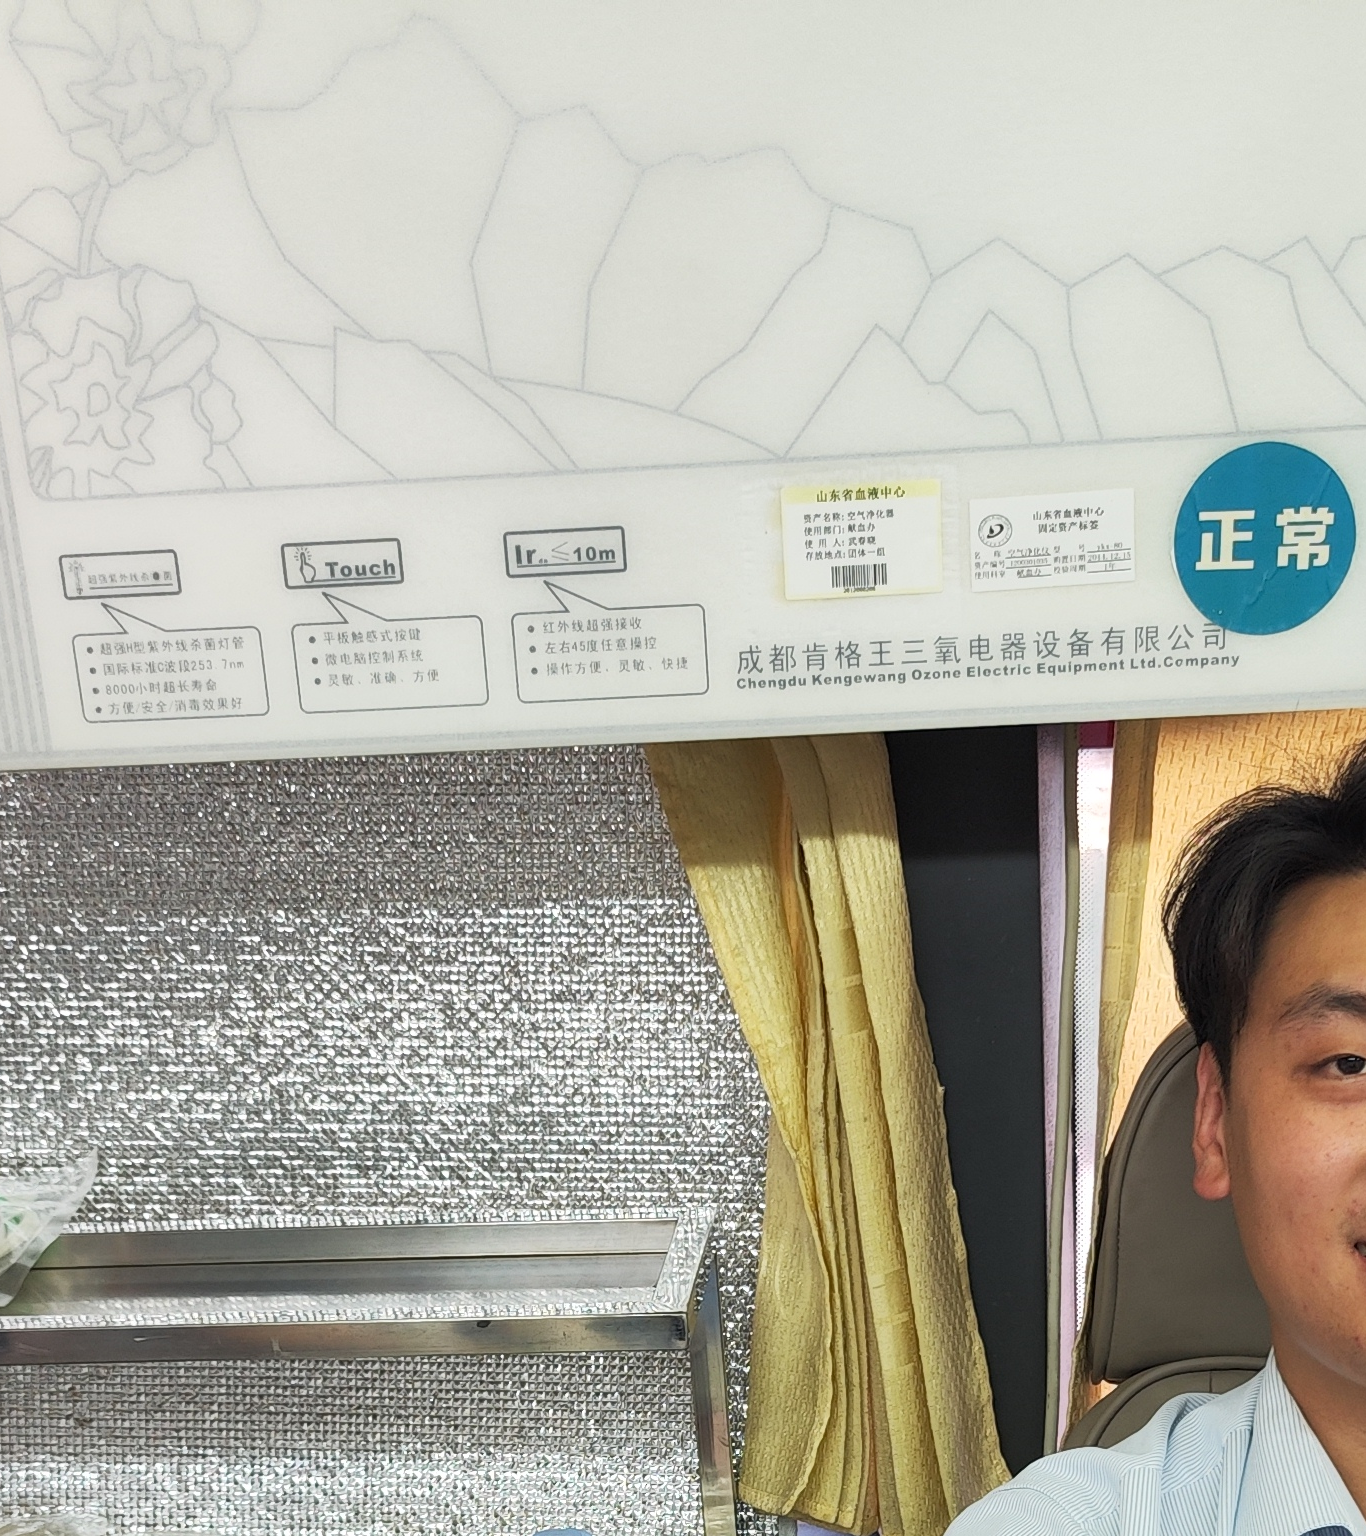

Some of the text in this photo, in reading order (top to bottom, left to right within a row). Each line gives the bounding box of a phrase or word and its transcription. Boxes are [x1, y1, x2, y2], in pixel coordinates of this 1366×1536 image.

[816, 485, 906, 503] 山东省血液中心
[1032, 506, 1105, 521] 山东省血液中心
[1195, 505, 1335, 573] 正常
[573, 546, 616, 562] 10m
[325, 558, 396, 578] Touch
[542, 616, 642, 634] 红外线超强接收
[323, 628, 422, 645] 平板触感式按键
[325, 649, 424, 666] 微电脑控制系统
[737, 623, 1227, 675] 成都肯格王三氧电器设备有限公司
[736, 675, 807, 690] Chengdu
[811, 671, 907, 687] Kengewang
[911, 667, 961, 681] Ozone
[966, 663, 1031, 679] Electric
[1036, 658, 1125, 676] Equipment
[105, 678, 217, 695] 8000小时超长寿命
